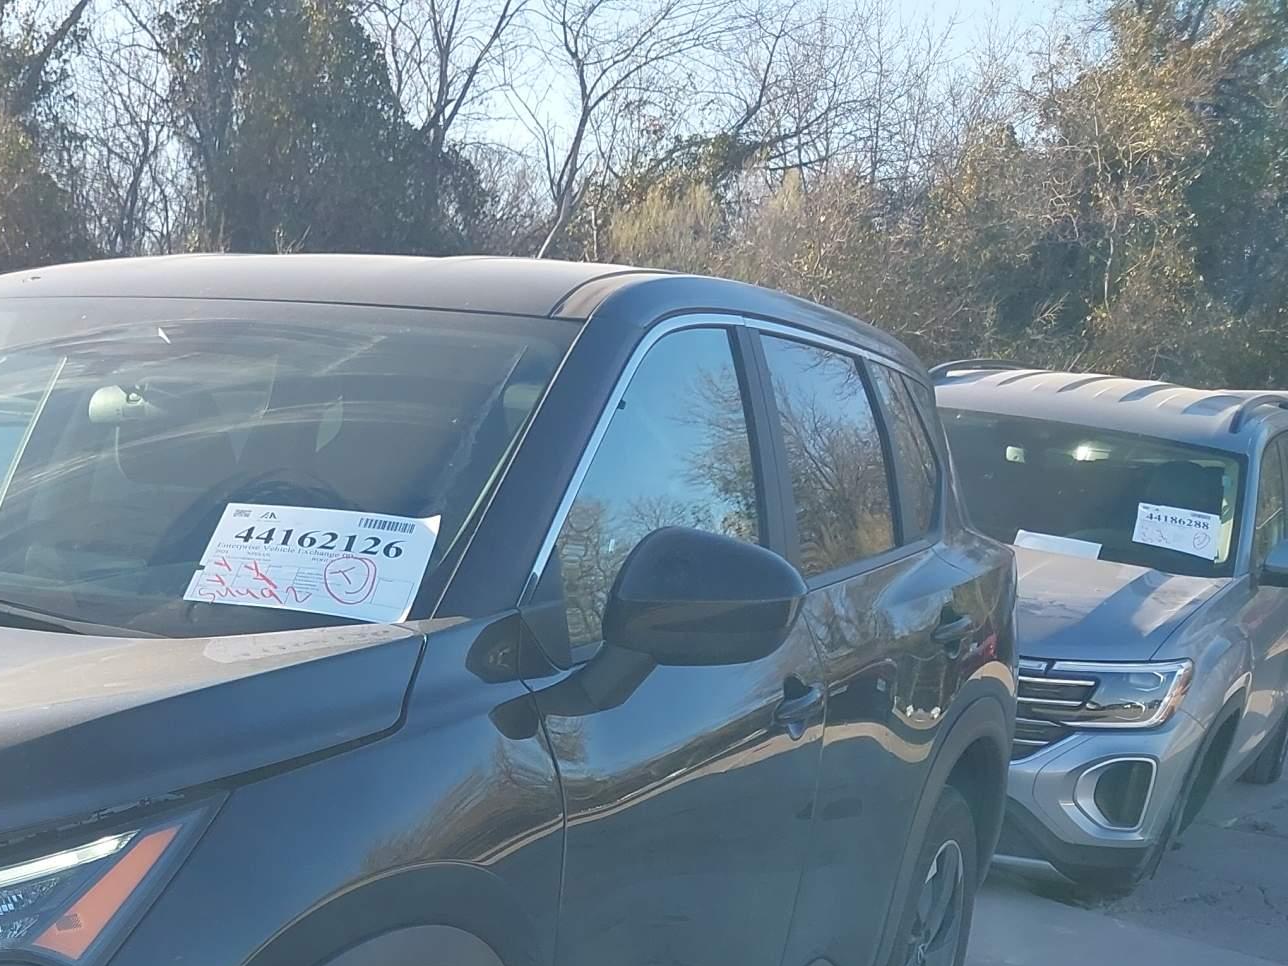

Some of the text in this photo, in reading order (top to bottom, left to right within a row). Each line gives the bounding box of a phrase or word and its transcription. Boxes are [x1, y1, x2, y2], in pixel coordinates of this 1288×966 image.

[1145, 512, 1210, 530] 44186288
[216, 542, 261, 556] Enterprise
[263, 545, 295, 554] Vehicle
[297, 548, 340, 560] Exchange
[234, 526, 408, 559] 44162126
